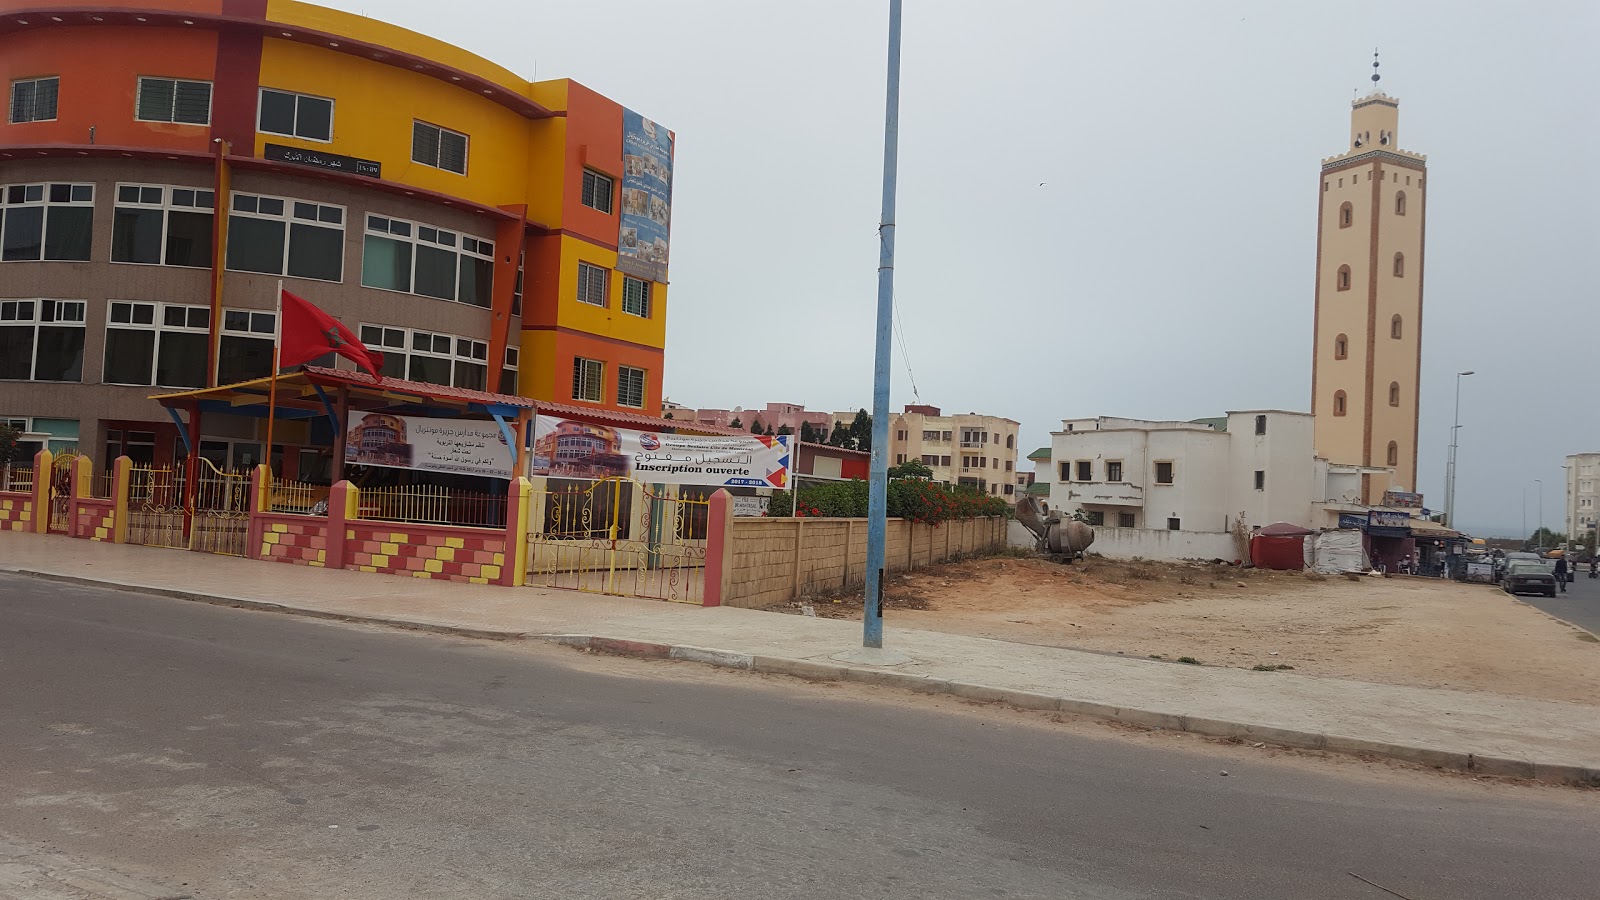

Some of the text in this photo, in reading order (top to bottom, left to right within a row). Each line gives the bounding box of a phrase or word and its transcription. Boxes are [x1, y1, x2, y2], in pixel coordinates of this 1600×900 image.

[304, 156, 326, 165] رمضان
[416, 425, 496, 439] مجموعة مدارس جزيرة مونتريال
[437, 438, 453, 446] التربوية
[635, 452, 752, 465] التسجيل مفتوح
[635, 462, 750, 475] Inscription ouverte
